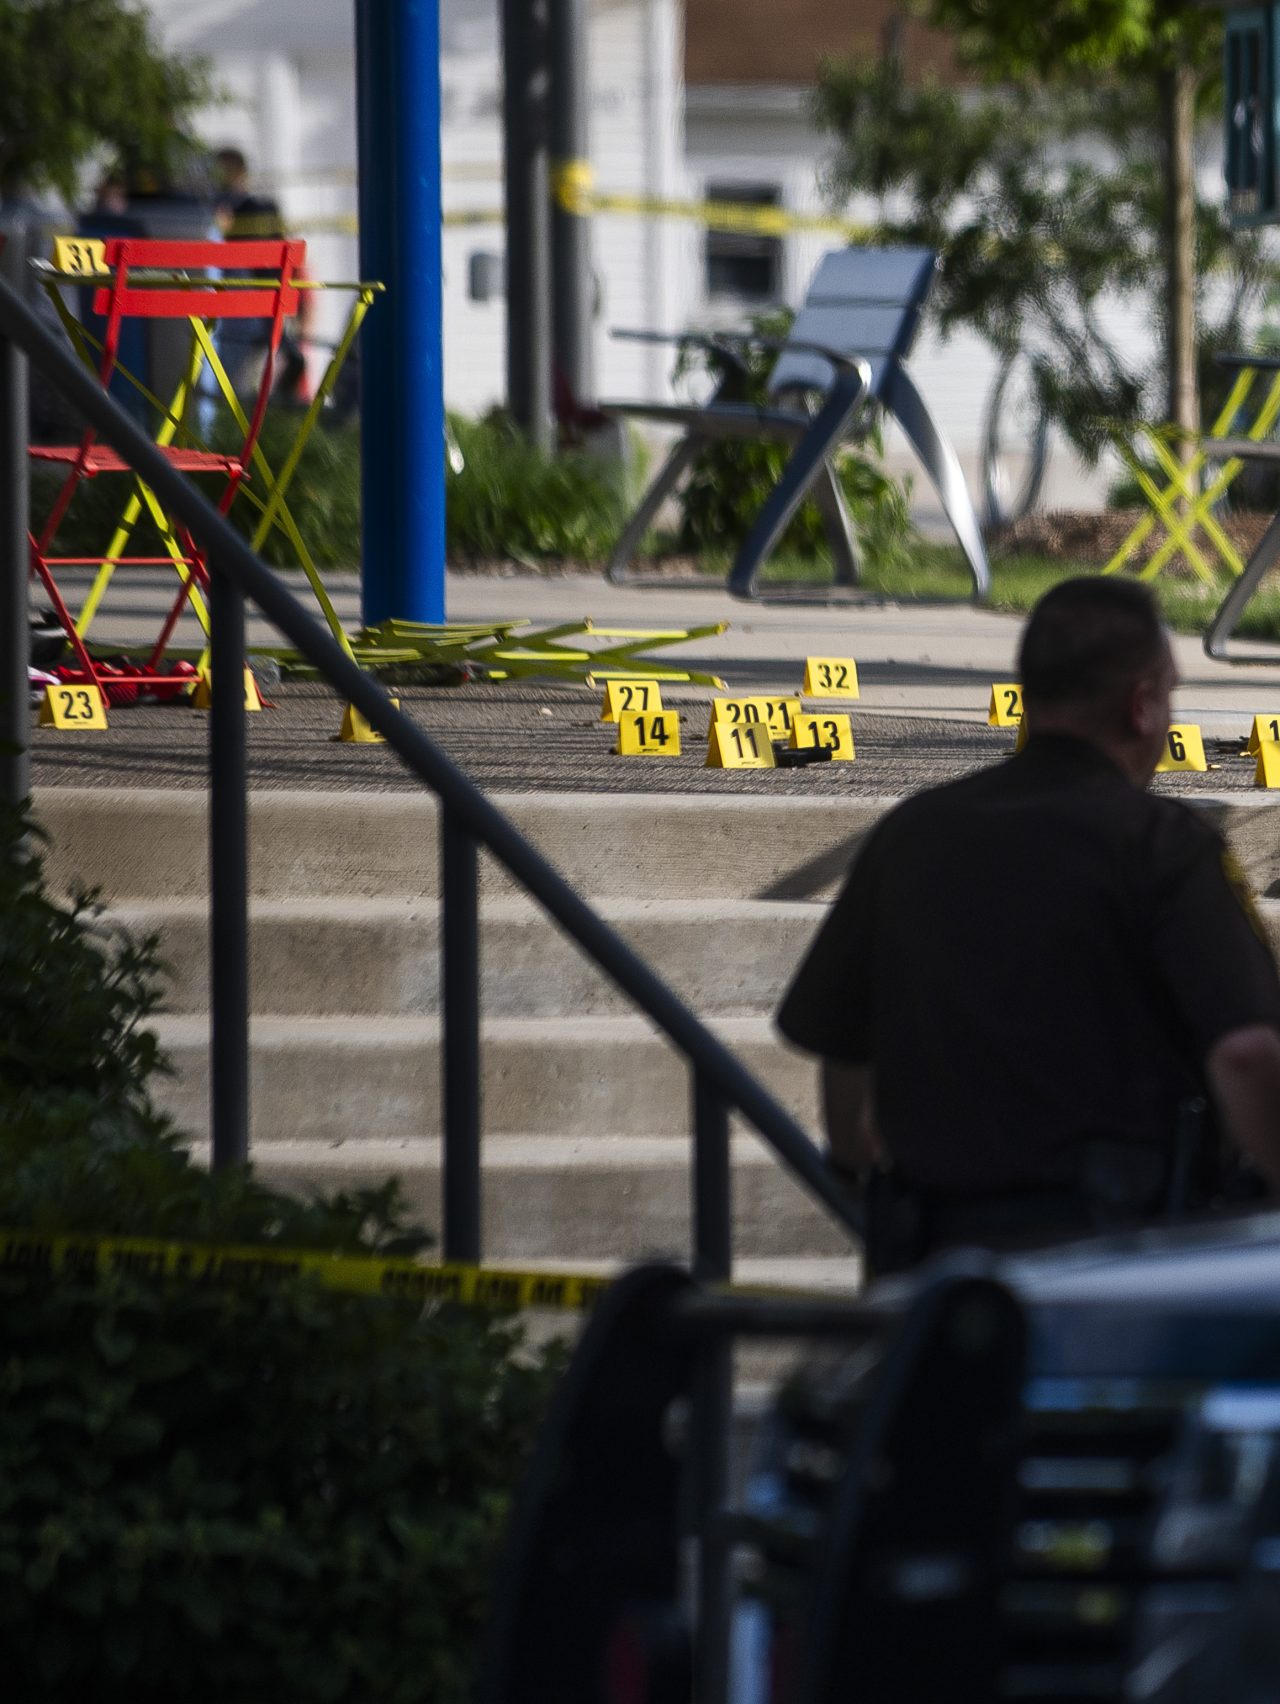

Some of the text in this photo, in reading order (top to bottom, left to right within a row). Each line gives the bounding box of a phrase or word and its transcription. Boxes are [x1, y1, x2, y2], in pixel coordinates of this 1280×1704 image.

[68, 244, 98, 272] 31
[818, 664, 850, 690] 32
[59, 691, 94, 720] 23
[619, 686, 648, 711] 27
[633, 716, 669, 746] 14
[731, 728, 759, 759] 11
[808, 720, 840, 751] 13
[1166, 730, 1186, 762] 6
